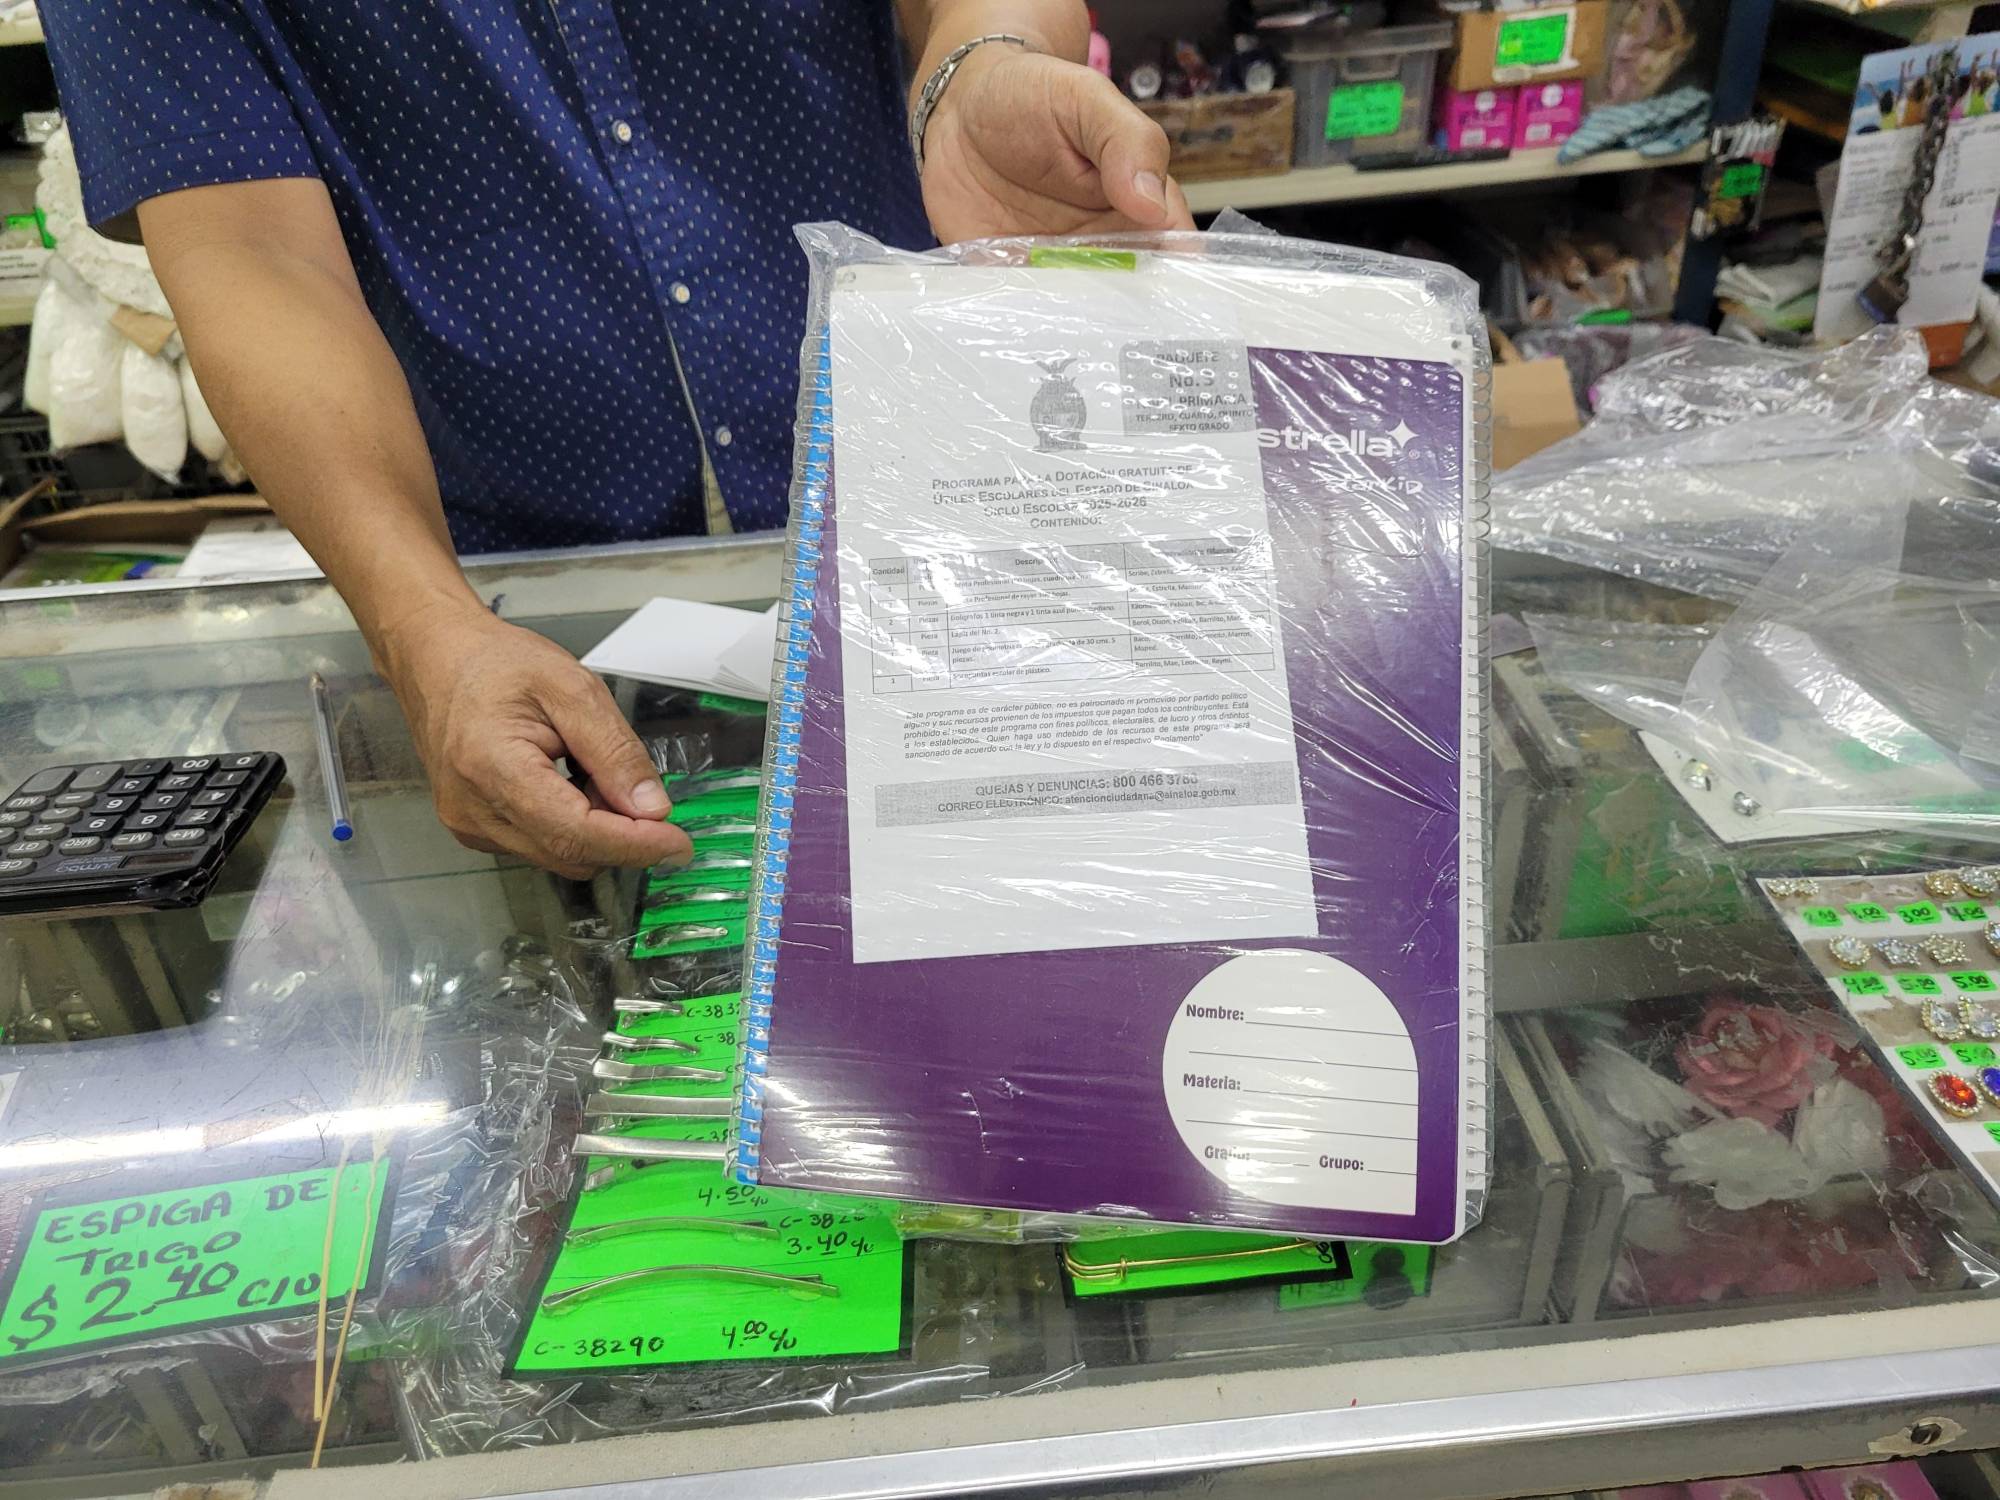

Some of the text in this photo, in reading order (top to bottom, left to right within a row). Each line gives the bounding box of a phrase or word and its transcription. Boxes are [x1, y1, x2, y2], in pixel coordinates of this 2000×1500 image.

[1199, 422, 1230, 430] GRADO
[1257, 425, 1394, 457] strella
[932, 477, 1001, 490] PROGRAMA
[978, 489, 1048, 503] ESCOLARES
[1125, 483, 1140, 493] DE
[1030, 516, 1103, 529] CONTENIDO:
[872, 567, 905, 576] Cantidad
[926, 708, 965, 719] programa
[966, 707, 976, 715] es
[979, 705, 989, 713] de
[1068, 700, 1078, 708] es
[1080, 698, 1125, 708] patrocinado
[1136, 696, 1176, 706] promovido
[1178, 696, 1191, 704] por
[1193, 693, 1220, 702] partido
[954, 716, 989, 725] recursos
[990, 714, 1028, 724] provienen
[1030, 712, 1040, 720] de
[1041, 711, 1053, 719] los
[1055, 710, 1094, 719] impuestos
[1096, 709, 1110, 717] que
[1112, 708, 1136, 717] pagan
[1137, 705, 1159, 714] todos
[1160, 705, 1172, 713] los
[904, 729, 941, 740] prohibido
[981, 725, 998, 733] este
[1000, 723, 1038, 733] programa
[1056, 720, 1075, 728] fines
[1158, 715, 1169, 723] de
[1170, 714, 1189, 722] lucro
[986, 734, 1010, 743] Quien
[1014, 733, 1033, 742] haga
[1055, 730, 1089, 738] indebido
[1092, 728, 1103, 736] de
[1122, 726, 1155, 735] recursos
[1159, 725, 1169, 733] de
[904, 749, 950, 759] sancionado
[952, 747, 963, 755] de
[964, 745, 997, 754] acuerdo
[1024, 743, 1036, 752] ley
[1053, 739, 1090, 749] dispuesto
[1113, 736, 1152, 746] respectivo
[975, 783, 1024, 796] QUEJAS
[1027, 782, 1035, 792] Y
[1037, 779, 1110, 792] DENUNCIAS:
[1113, 776, 1136, 788] 800
[1139, 775, 1164, 786] 466
[938, 800, 984, 812] CORREO
[1186, 1004, 1244, 1021] Nombre:
[1183, 1073, 1241, 1091] Materia:
[1319, 1155, 1364, 1171] Grupo:
[44, 1177, 330, 1244] ESPIGA DE
[55, 1230, 242, 1277] TRIGO
[7, 1283, 59, 1352] $
